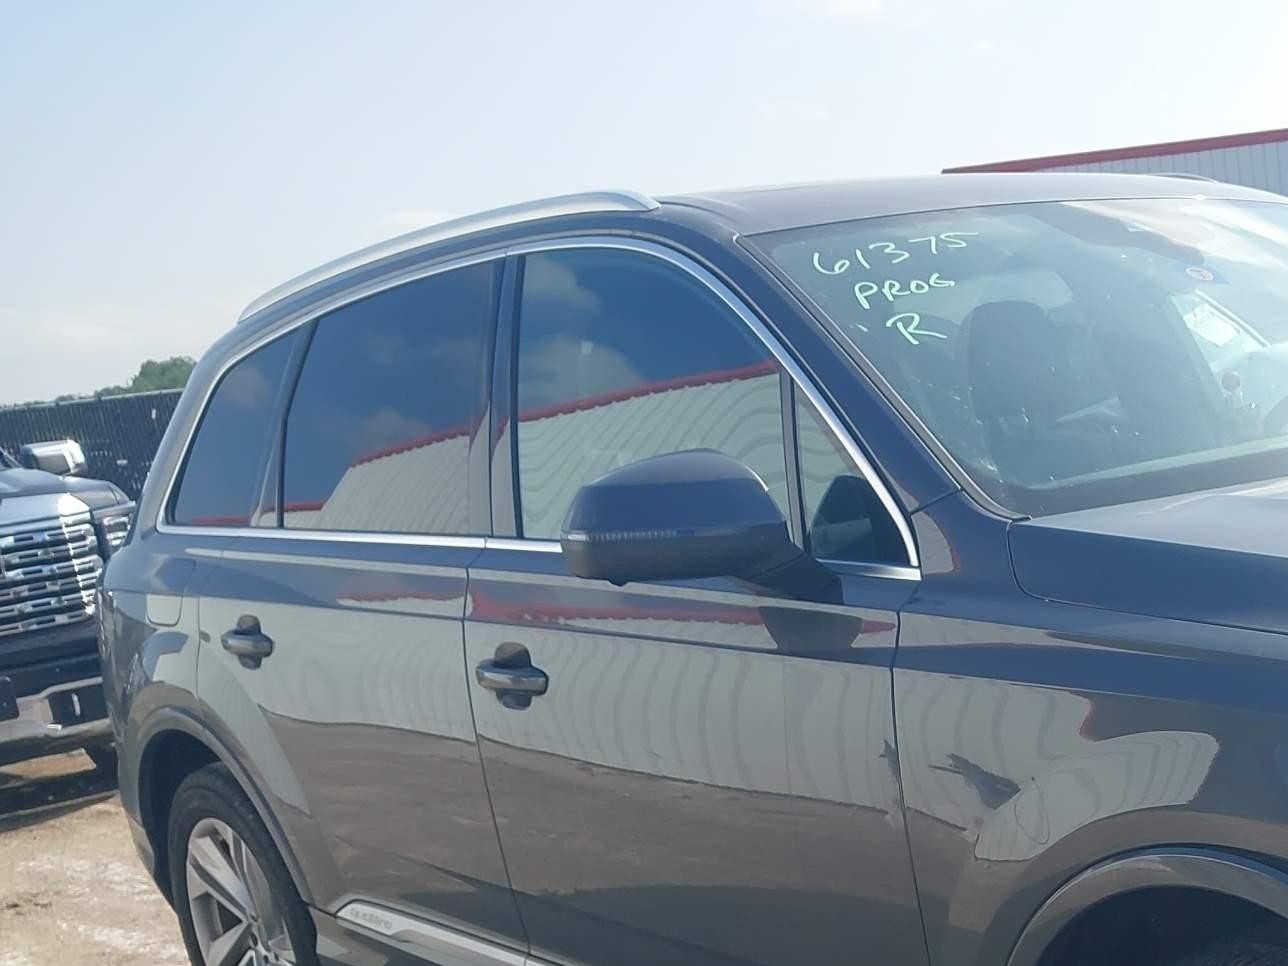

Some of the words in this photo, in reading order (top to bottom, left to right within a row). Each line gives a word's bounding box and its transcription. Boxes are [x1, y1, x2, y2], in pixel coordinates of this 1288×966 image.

[812, 231, 980, 275] 61375
[853, 272, 956, 310] PROG
[884, 312, 948, 345] R
